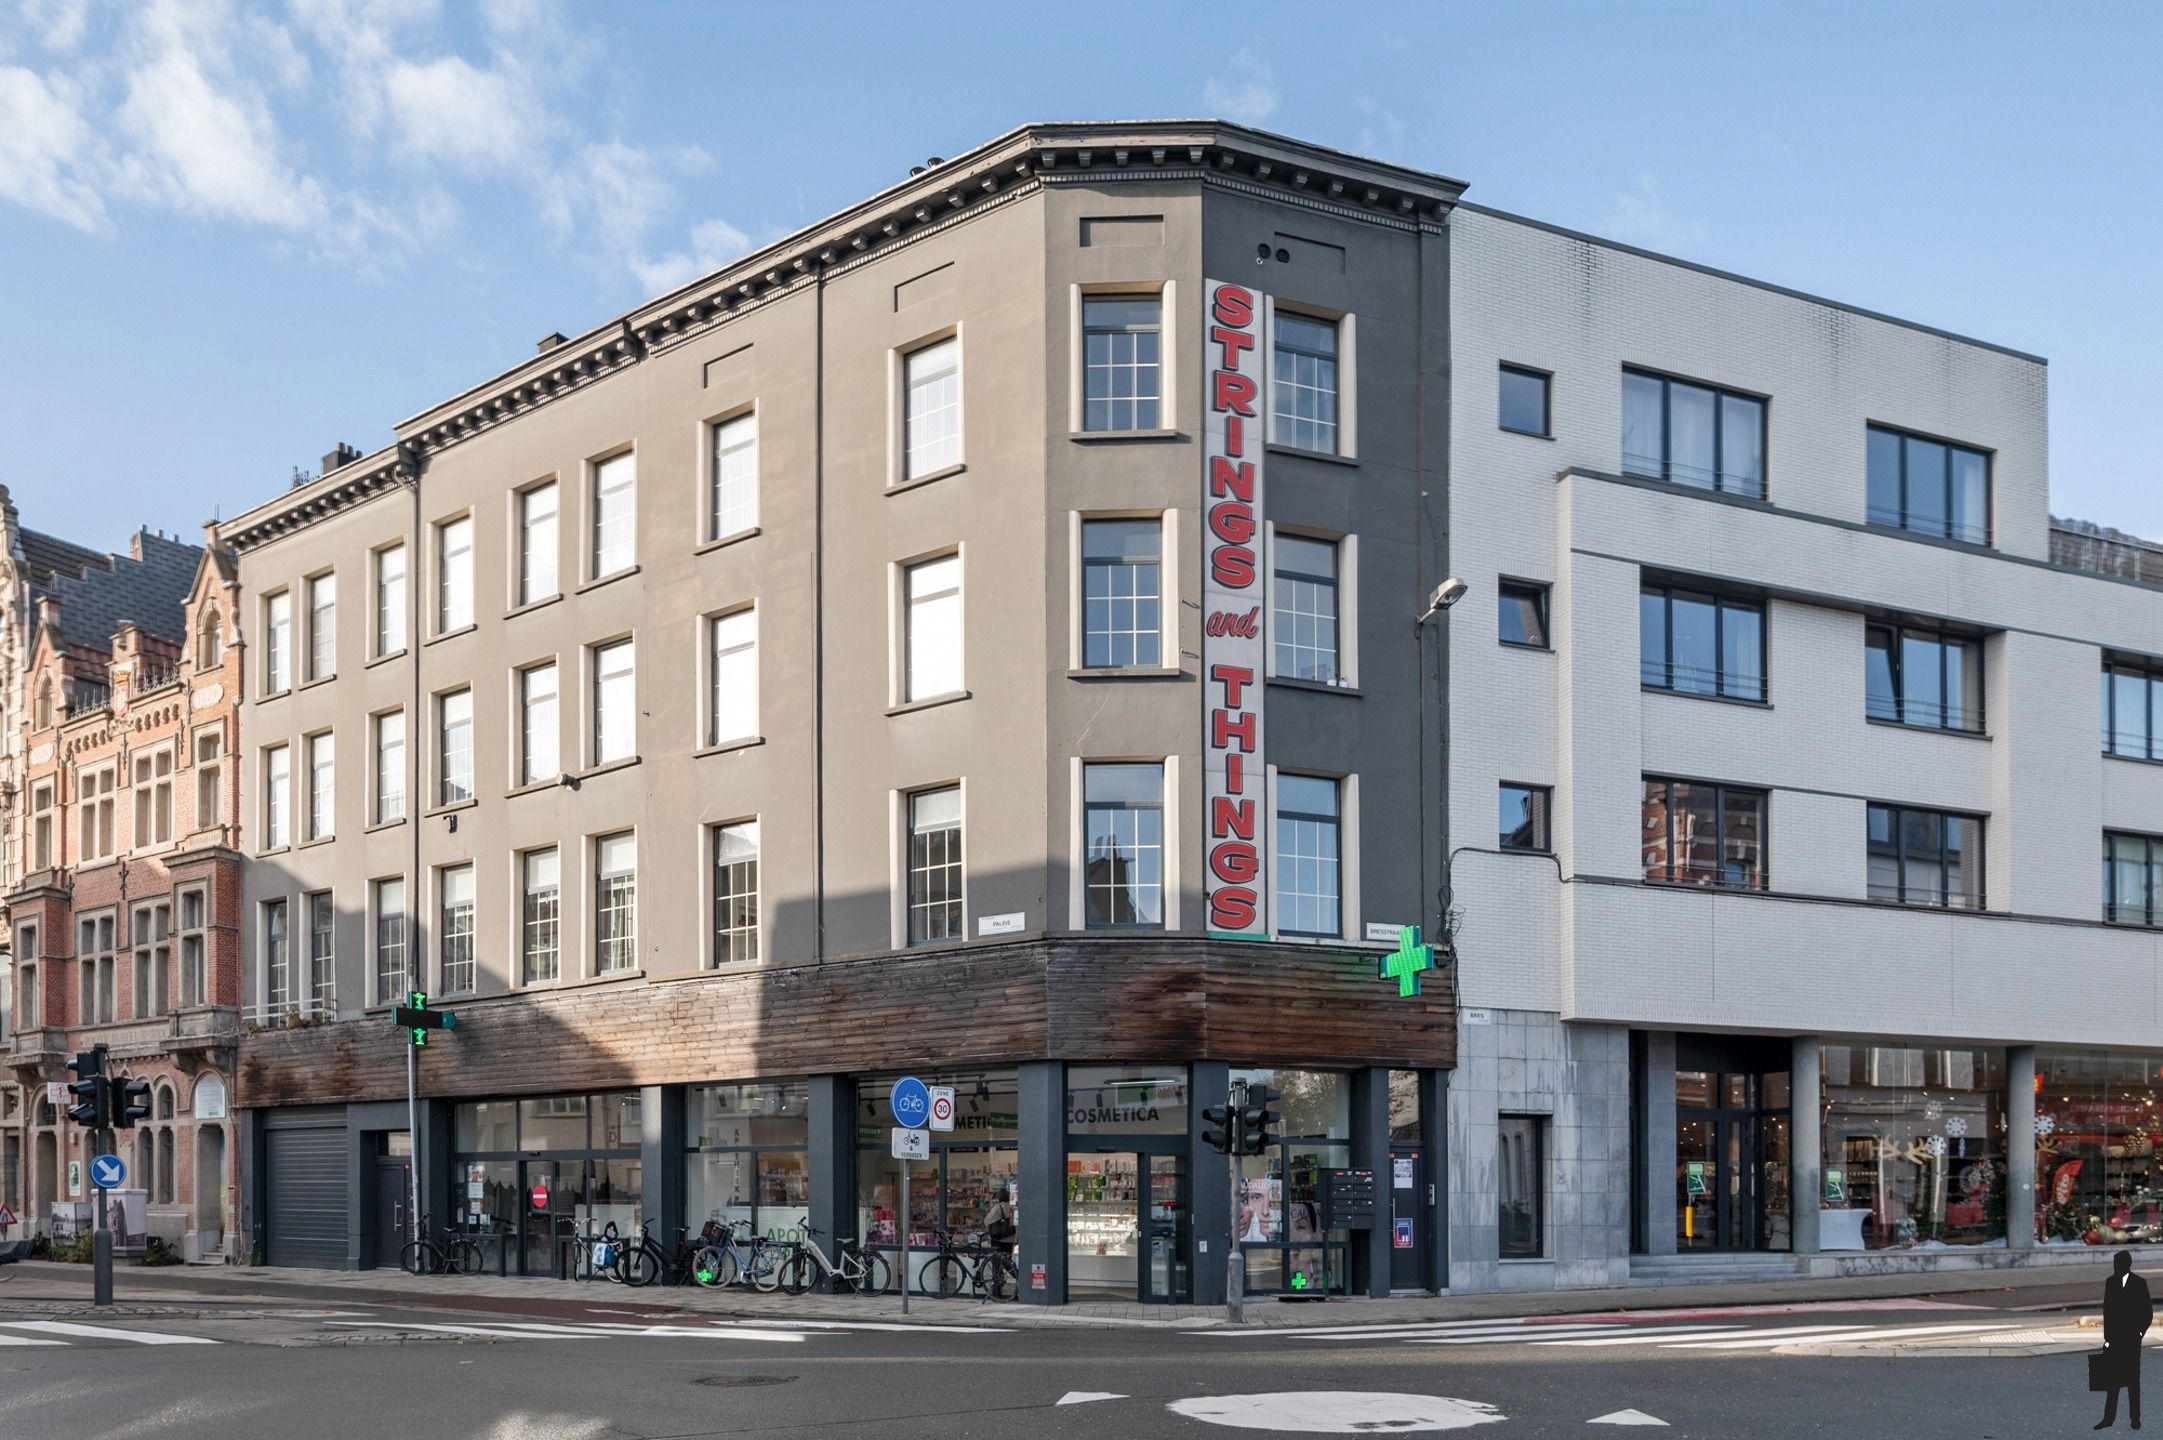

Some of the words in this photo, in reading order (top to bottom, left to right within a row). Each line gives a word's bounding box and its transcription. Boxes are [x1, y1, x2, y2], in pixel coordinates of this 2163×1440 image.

[1208, 284, 1258, 589] STRINGS
[1207, 605, 1260, 639] and
[1209, 664, 1259, 930] THINGS
[938, 1104, 948, 1114] 30
